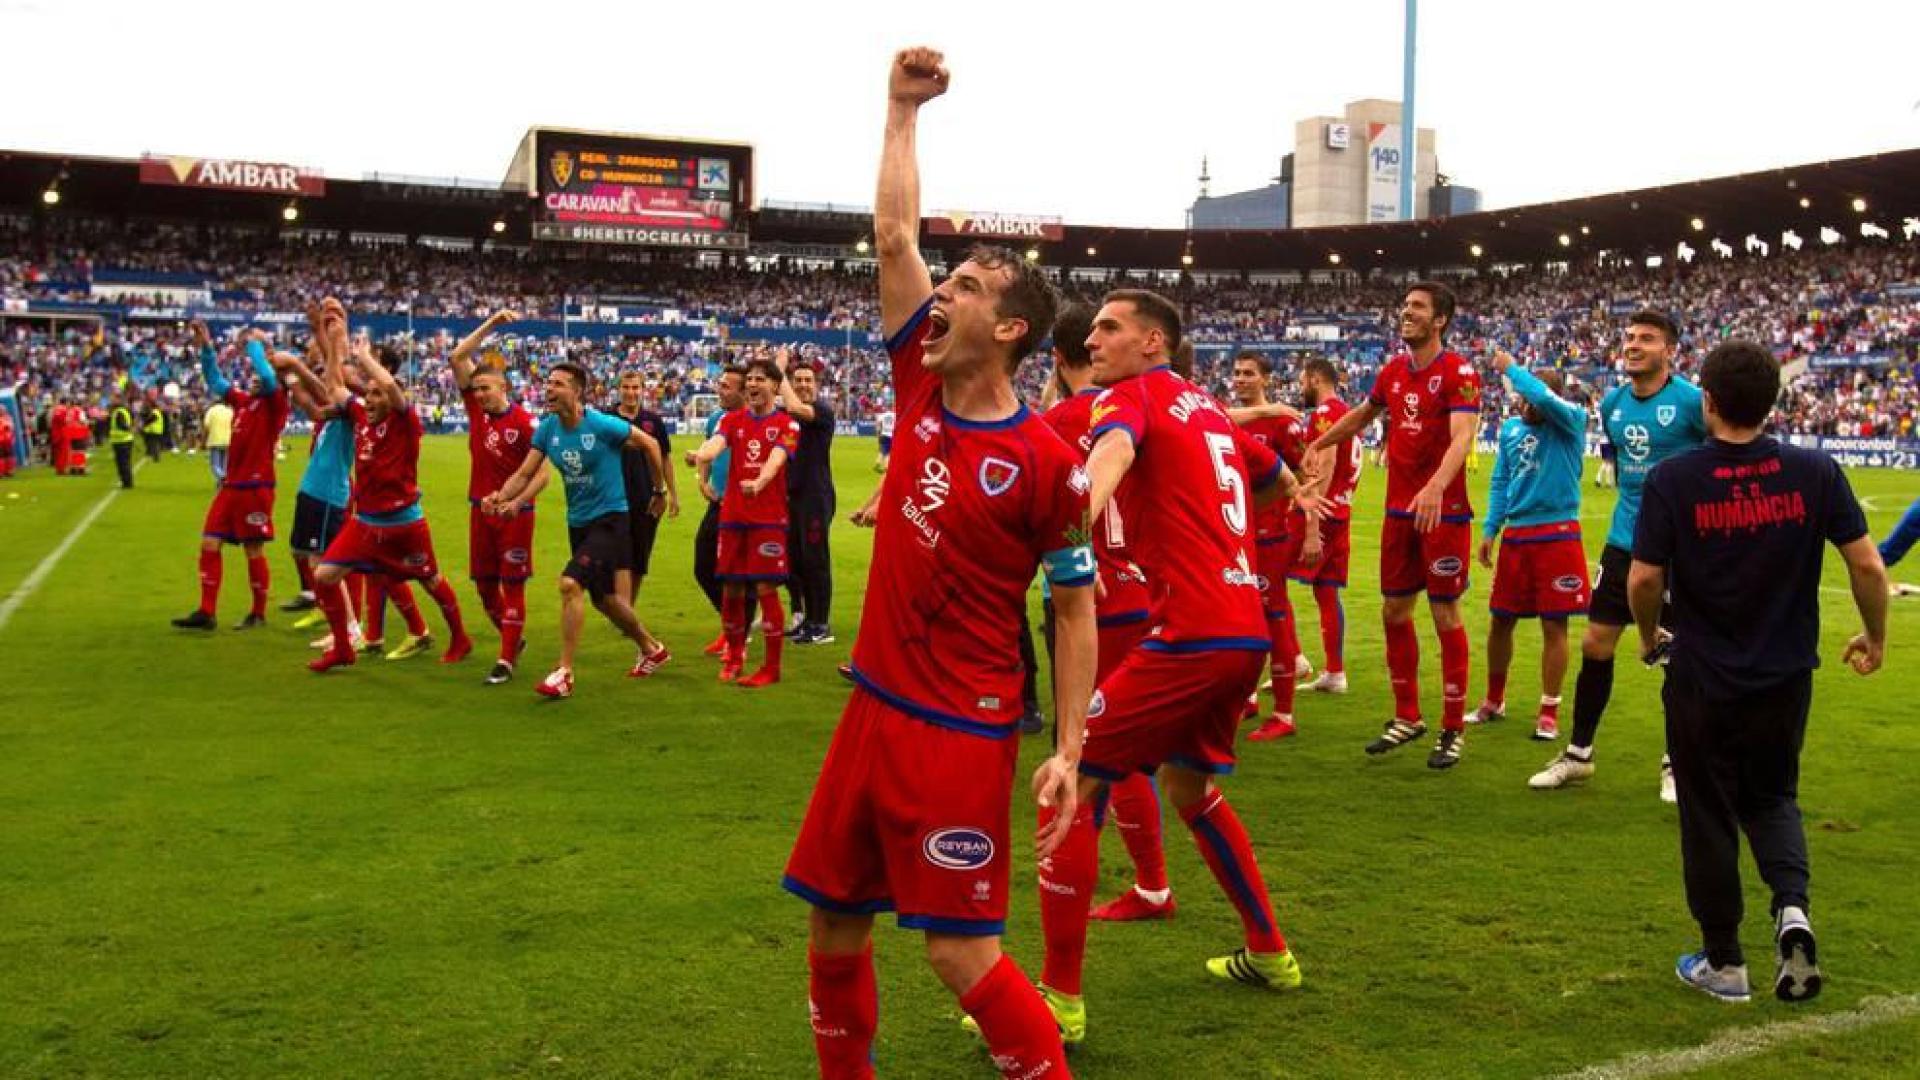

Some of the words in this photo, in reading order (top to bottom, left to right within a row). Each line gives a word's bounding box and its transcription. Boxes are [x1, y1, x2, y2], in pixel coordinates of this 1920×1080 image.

[1371, 146, 1399, 171] 140
[198, 159, 300, 191] AMBAR
[573, 226, 713, 246] #HERETOCREATE
[968, 217, 1045, 236] AMBAR
[1203, 431, 1247, 537] 5
[1694, 491, 1807, 530] NUMANCIA
